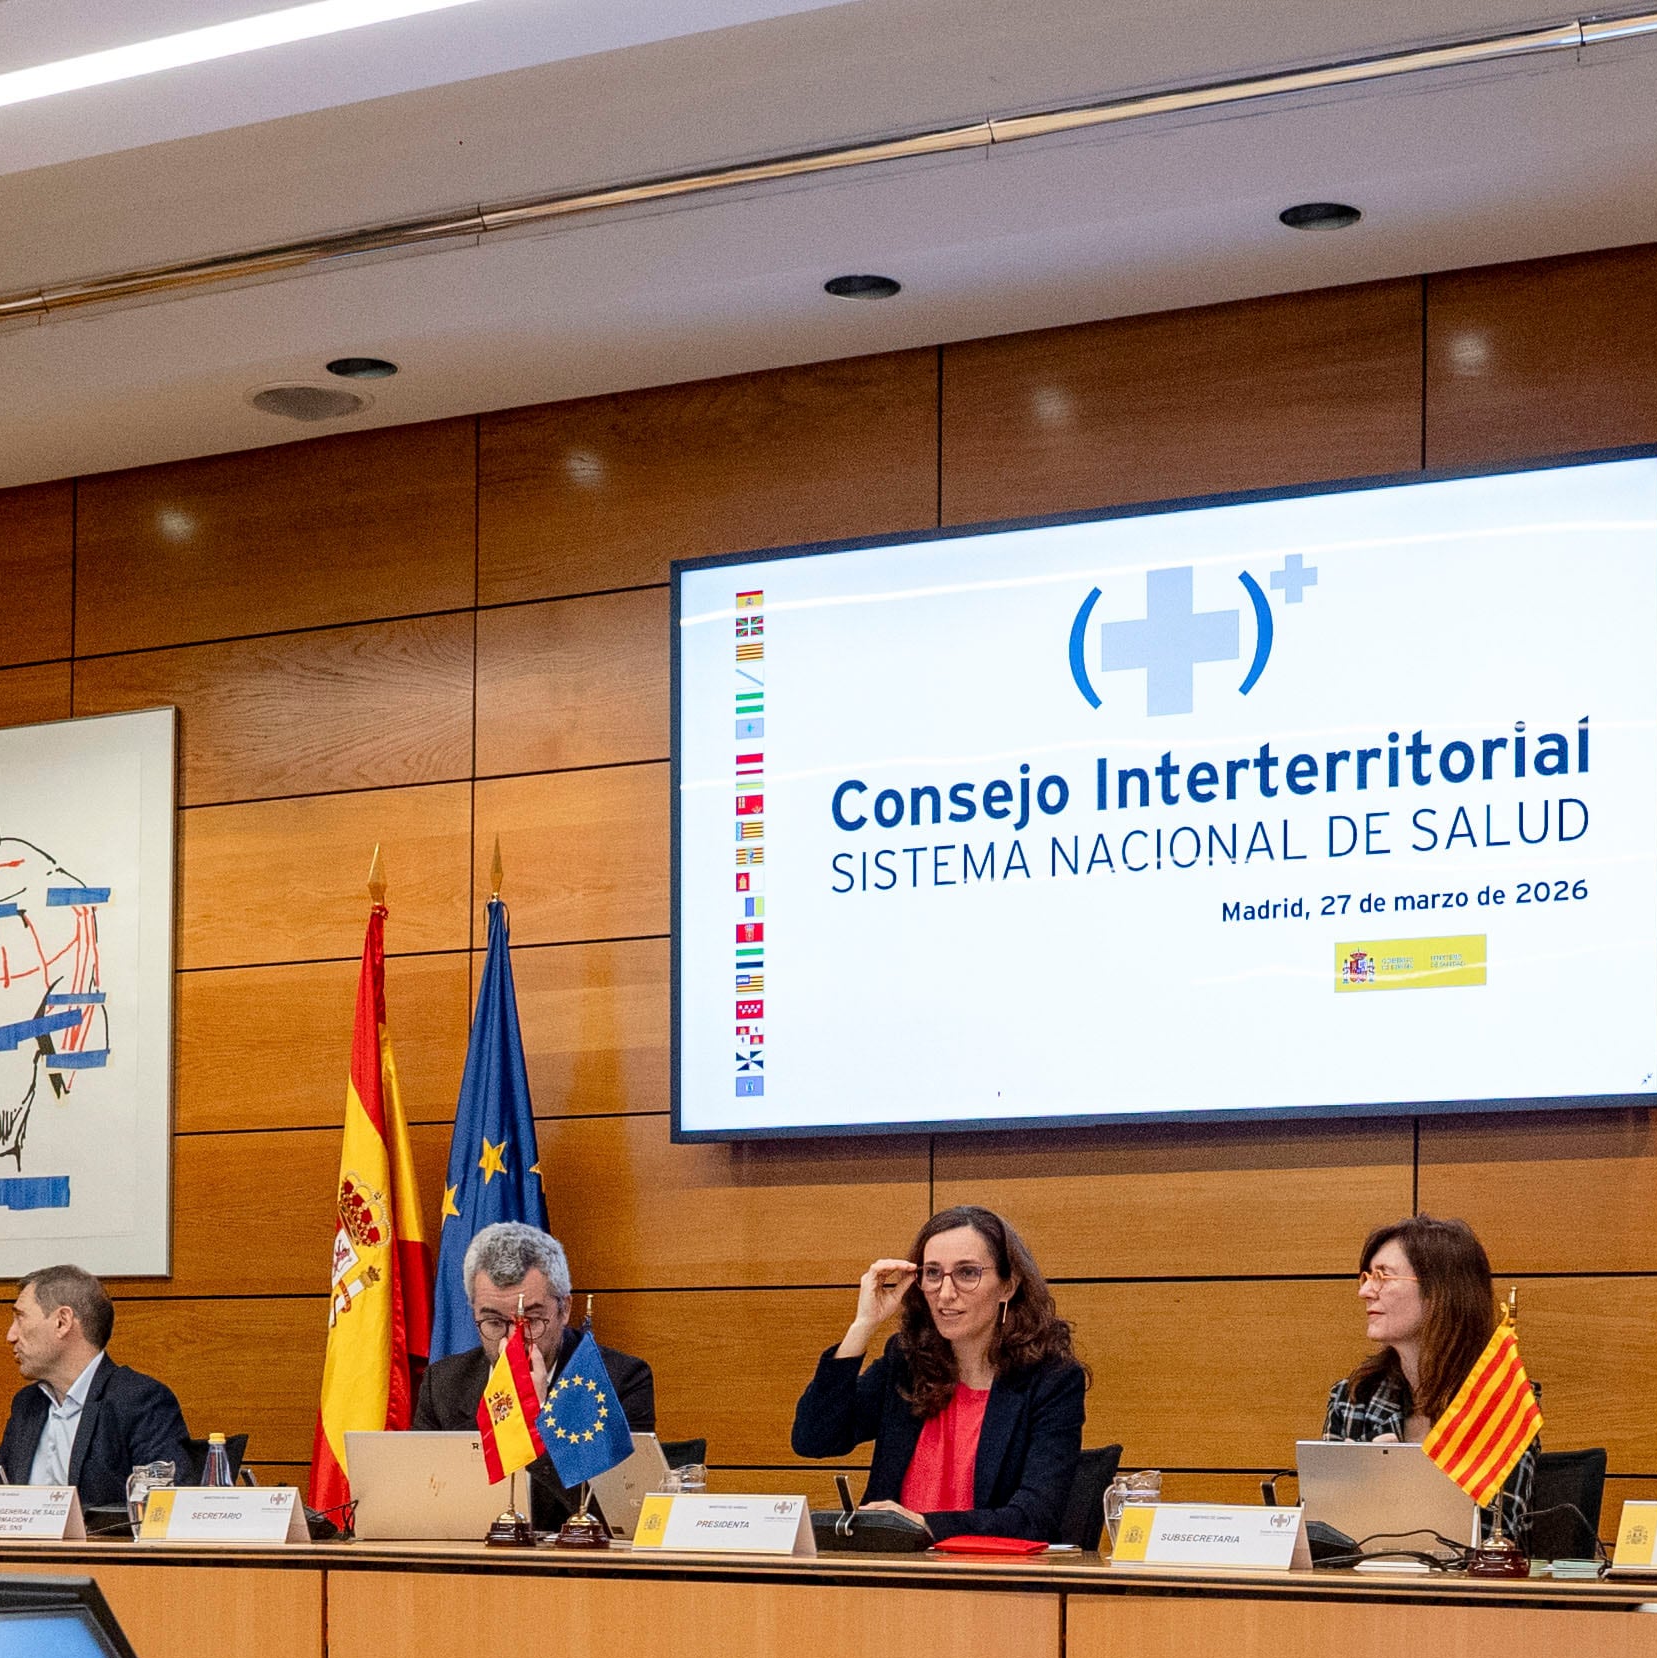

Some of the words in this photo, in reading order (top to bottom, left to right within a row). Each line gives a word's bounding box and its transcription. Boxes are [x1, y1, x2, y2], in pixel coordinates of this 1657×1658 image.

[831, 763, 1070, 832] Consejo
[1096, 715, 1590, 811] Interterritorial
[831, 839, 1031, 894] SISTEMA
[1051, 819, 1308, 878] NACIONAL
[1328, 811, 1391, 858] DE
[1411, 797, 1590, 852] SALUD
[1222, 898, 1312, 923] Madrid,
[1320, 894, 1352, 916] 27
[1359, 892, 1386, 914] de
[1394, 892, 1469, 912] marzo
[1477, 885, 1506, 907] de
[1515, 879, 1589, 904] 2026
[191, 1511, 243, 1521] SECRETARIO
[695, 1519, 751, 1529] PRESIDENTA
[1160, 1532, 1241, 1544] SUBSECRETARIA
